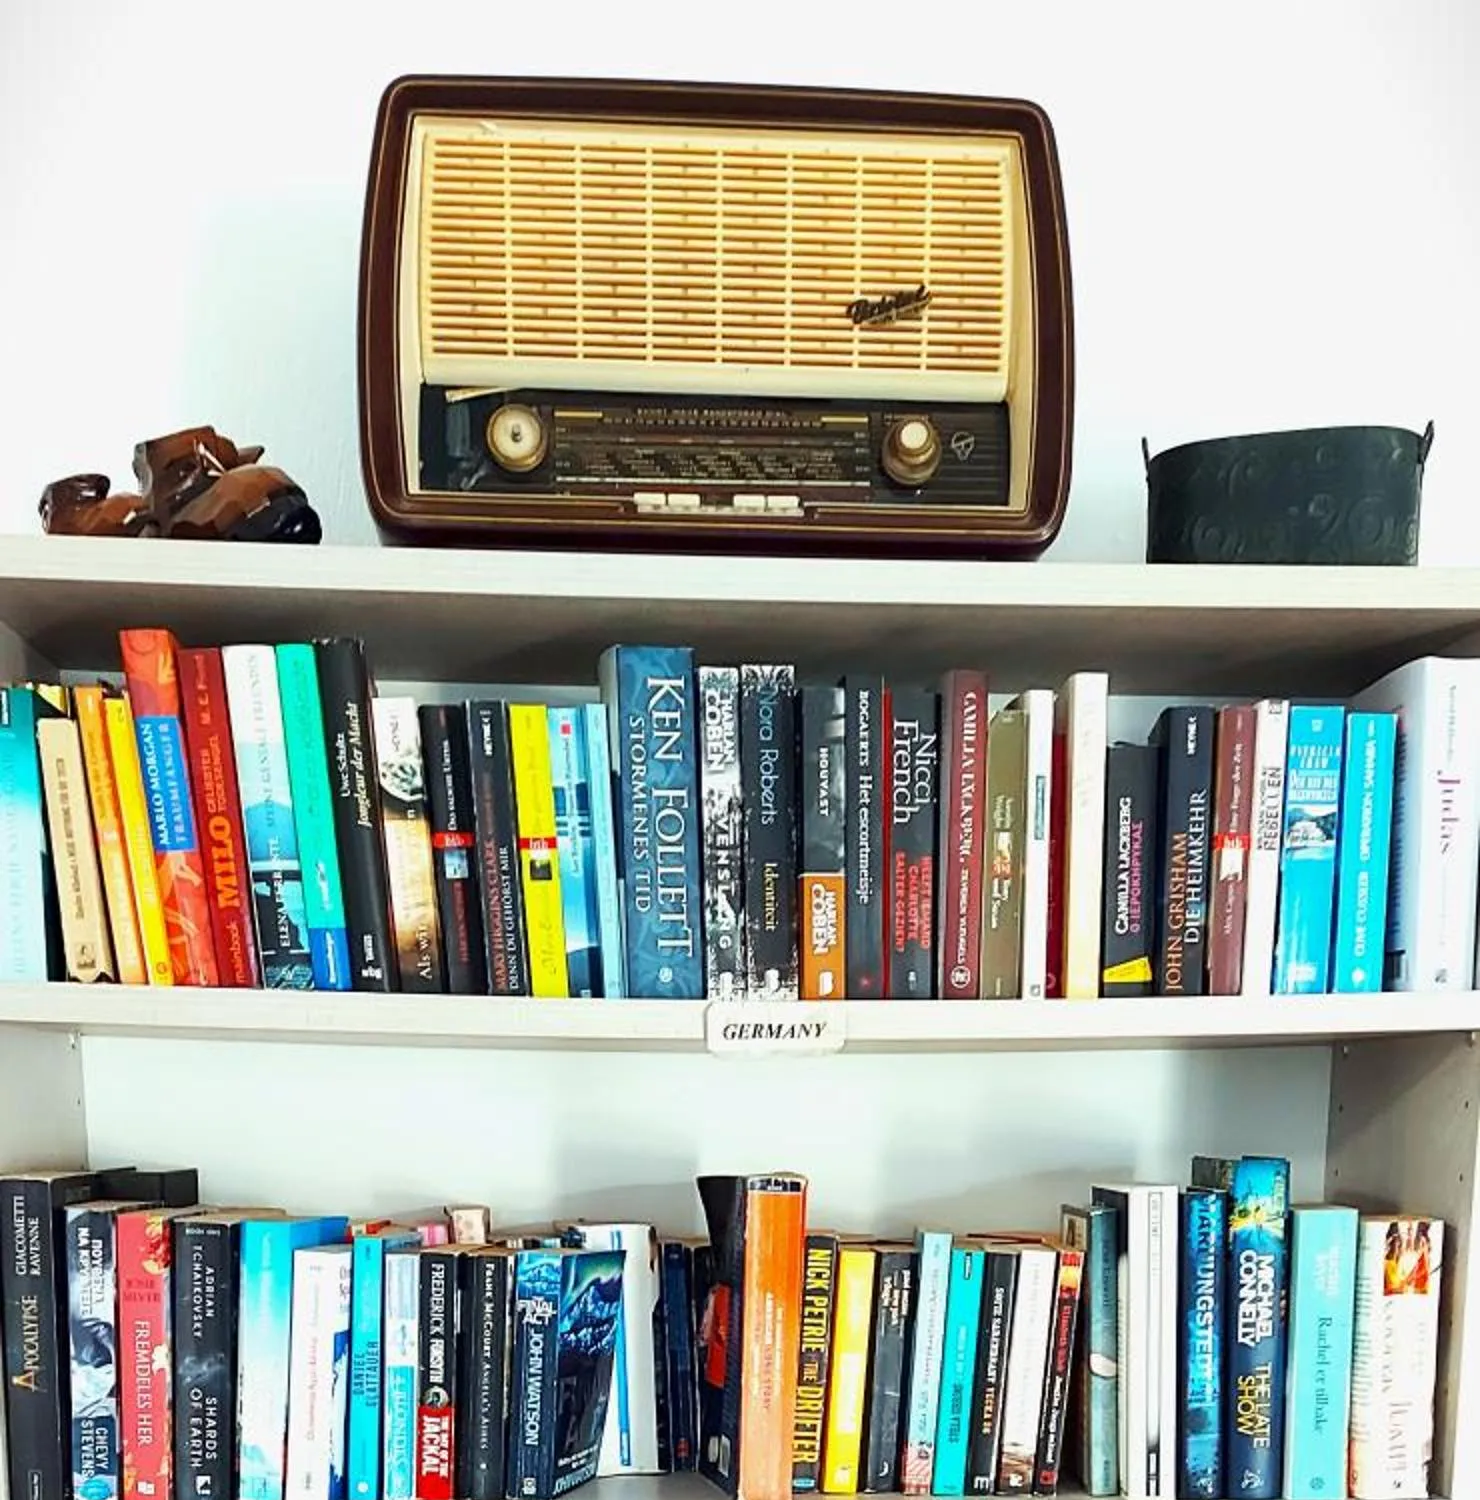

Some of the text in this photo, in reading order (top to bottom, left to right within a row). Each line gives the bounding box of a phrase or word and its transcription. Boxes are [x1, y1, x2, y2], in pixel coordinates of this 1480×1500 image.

[345, 702, 372, 827] Jongleur der Macht
[705, 689, 723, 770] COBEN
[759, 689, 778, 825] Nora Roberts
[916, 732, 937, 804] Nicci
[140, 723, 170, 844] MARLO MORGAN
[818, 747, 829, 817] HOUVAST
[857, 775, 873, 805] Het
[892, 719, 920, 824] French
[629, 716, 651, 912] STORMENES TID
[646, 675, 694, 957] KEN FOLLETT
[209, 815, 241, 908] MILO
[1184, 789, 1207, 943] DIE HEIMKEHR
[275, 904, 291, 947] ELENA
[809, 883, 828, 954] COBEN
[1115, 872, 1130, 935] CAMILLA
[1165, 832, 1187, 990] JOHN GRISHAM
[226, 921, 247, 983] mainbook
[418, 954, 433, 980] Als
[722, 1022, 828, 1040] GERMANY
[12, 1195, 27, 1275] GIACOMETTI
[27, 1217, 41, 1275] RAVENNE
[192, 1245, 204, 1339] TCHAIKOVSKY
[204, 1266, 215, 1318] ADRIAN
[429, 1263, 445, 1336] FREDERICK
[1237, 1249, 1257, 1348] CONNELLY
[1256, 1254, 1275, 1343] MICHAEL
[11, 1295, 48, 1393] APOCALYPSE
[134, 1320, 152, 1409] FREMDELES
[792, 1248, 832, 1464] NICK PETRIE THE DRIFTER
[1313, 1316, 1333, 1365] Rachel
[525, 1326, 544, 1447] JOHN WATSON
[1237, 1375, 1255, 1436] SHOW
[1253, 1362, 1272, 1448] THE LATE
[79, 1419, 95, 1477] STEVENS
[94, 1426, 109, 1471] CHEVY
[137, 1412, 153, 1446] HER
[189, 1387, 203, 1468] OF EARTH
[204, 1397, 217, 1460] SHARDS
[422, 1414, 441, 1477] JACKAL
